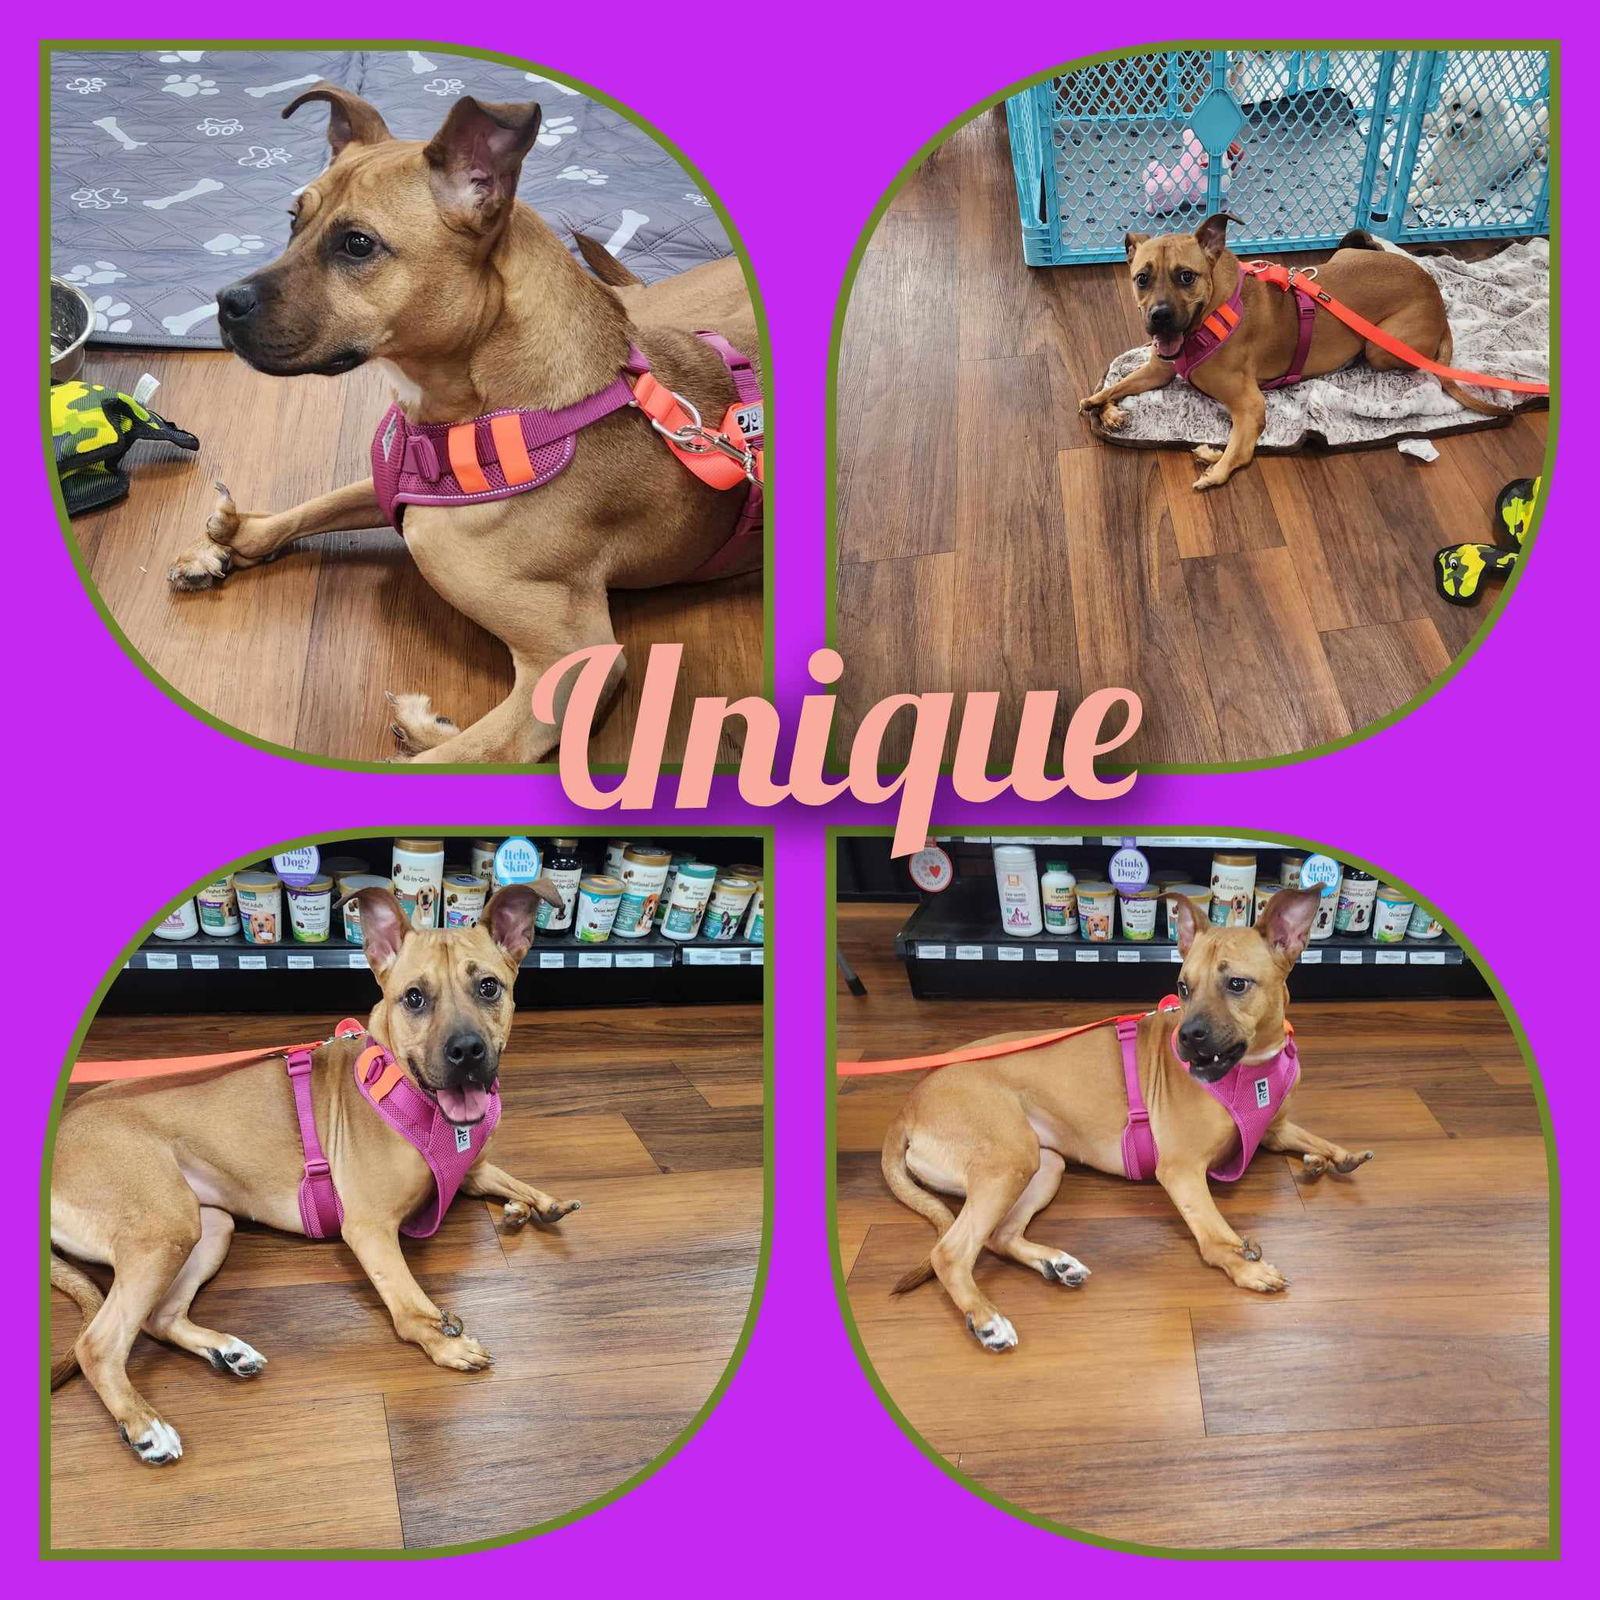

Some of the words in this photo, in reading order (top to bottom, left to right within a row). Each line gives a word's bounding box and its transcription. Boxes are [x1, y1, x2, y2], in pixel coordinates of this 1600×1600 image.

[282, 857, 310, 871] Dog?
[503, 860, 535, 873] Skin?
[1113, 858, 1144, 869] Stinky
[1117, 868, 1142, 880] Dog?
